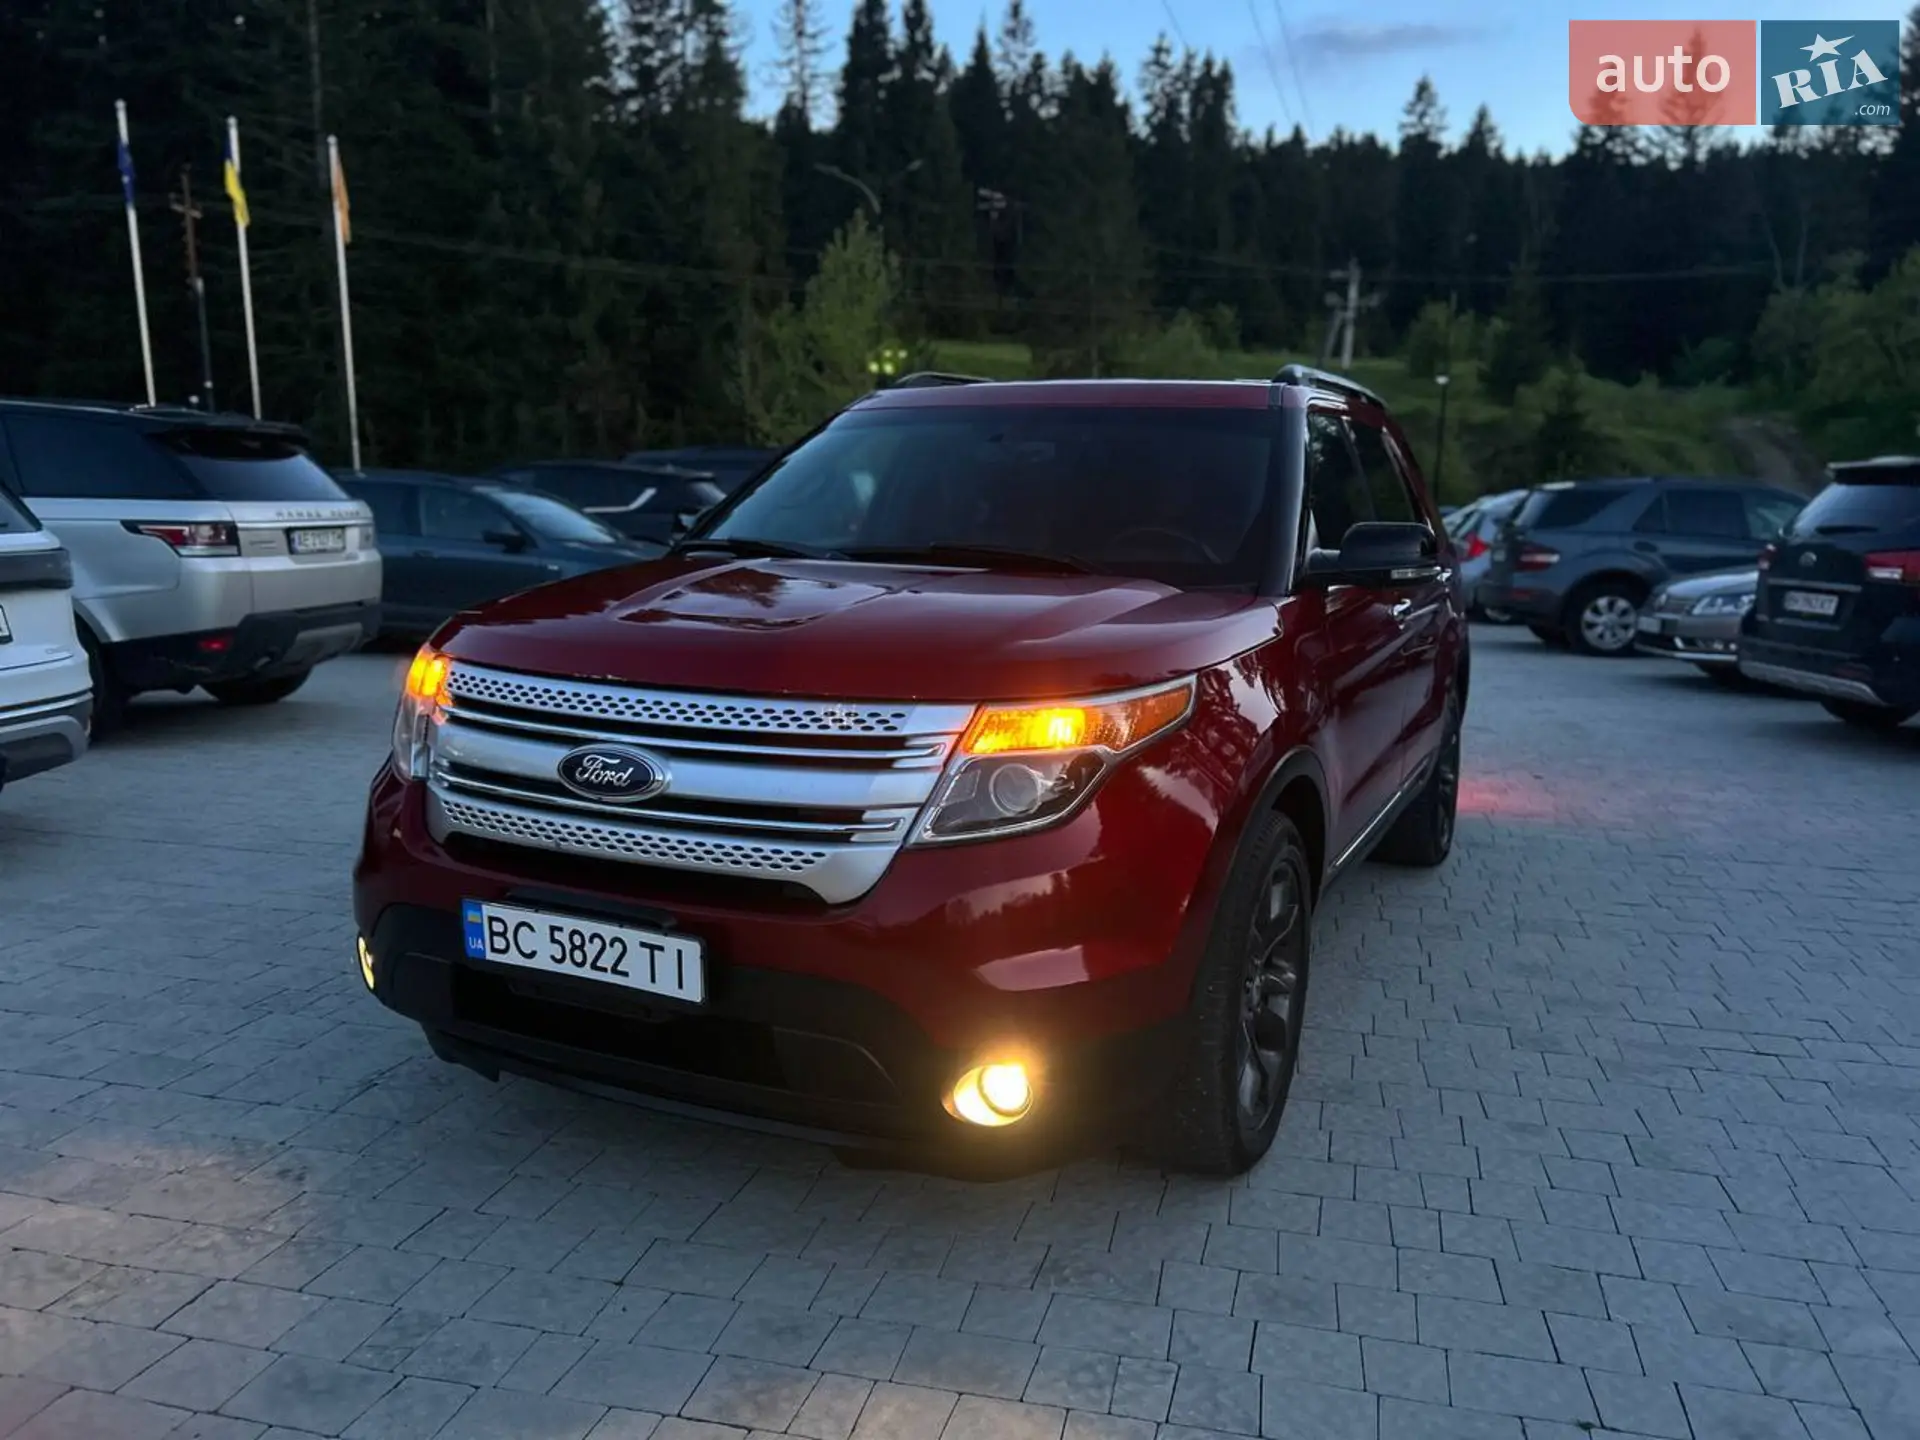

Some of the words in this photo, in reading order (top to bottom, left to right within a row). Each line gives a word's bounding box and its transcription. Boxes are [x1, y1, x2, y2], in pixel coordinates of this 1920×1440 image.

[575, 754, 635, 787] Ford
[468, 936, 484, 950] UA
[487, 916, 538, 960] BC
[548, 925, 630, 977] 5822
[639, 940, 684, 990] TI
